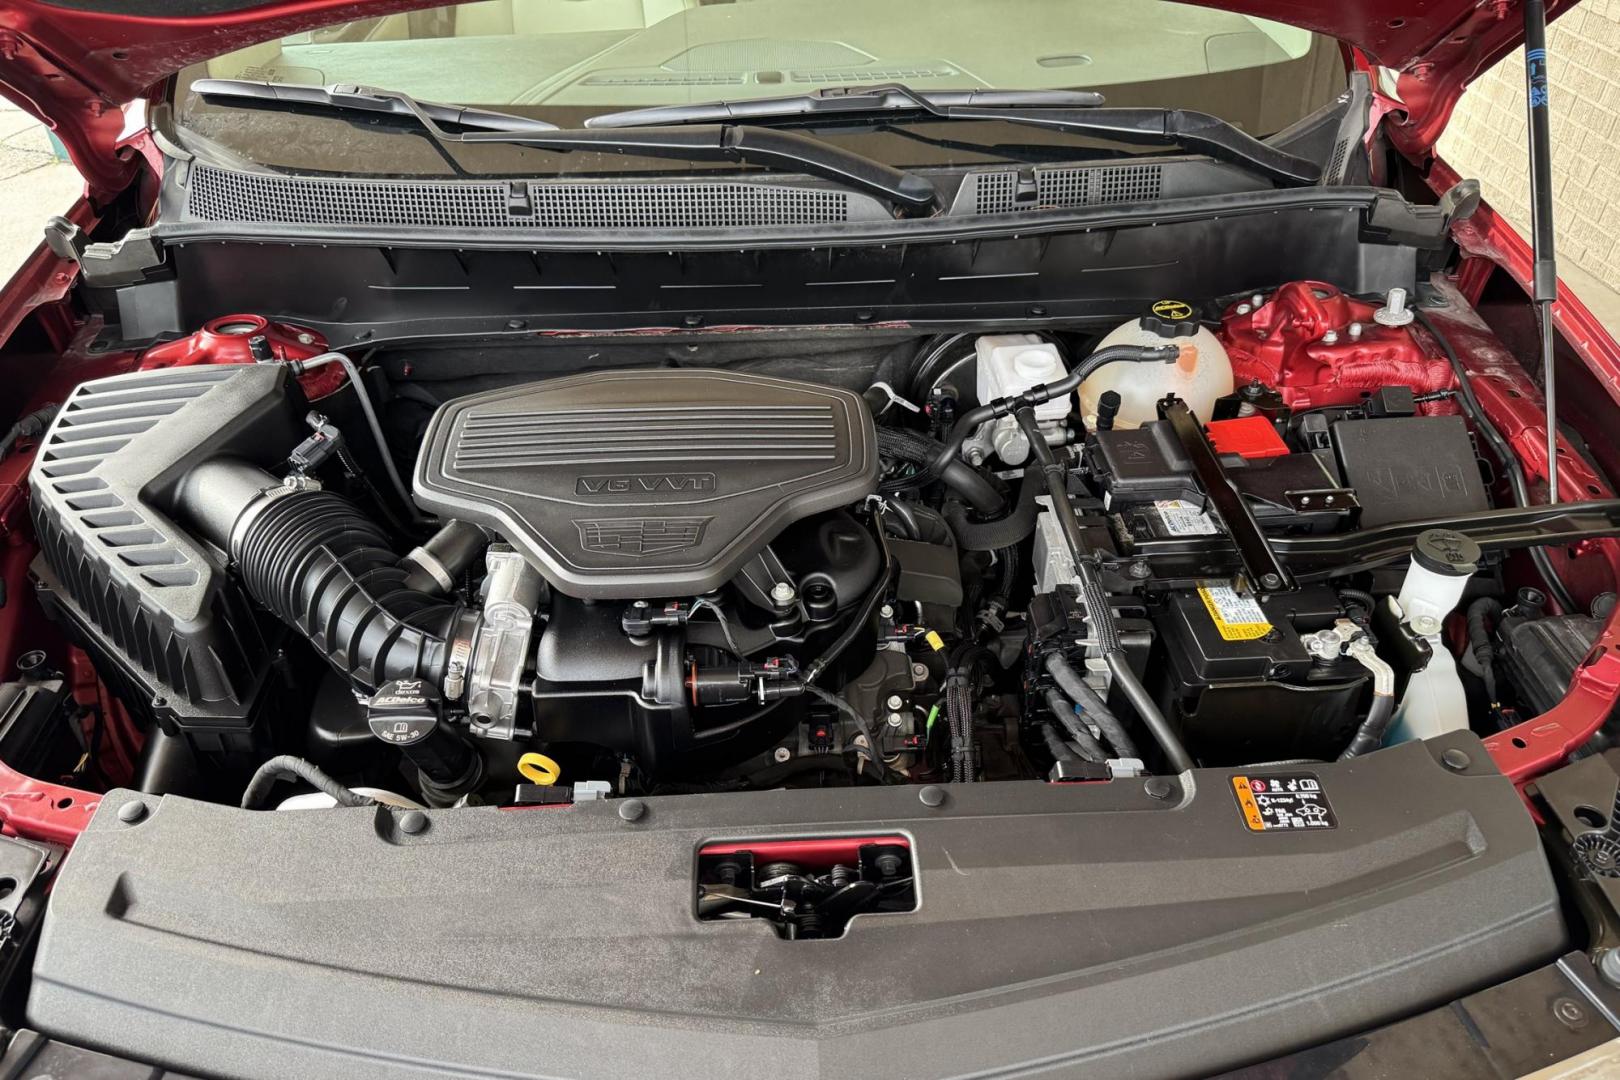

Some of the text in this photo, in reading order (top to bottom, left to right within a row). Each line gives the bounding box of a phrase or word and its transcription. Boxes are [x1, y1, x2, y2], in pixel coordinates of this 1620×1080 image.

[581, 476, 710, 492] V6 VVT
[374, 696, 426, 704] ACDelco
[381, 730, 420, 741] SAE 5W-30
